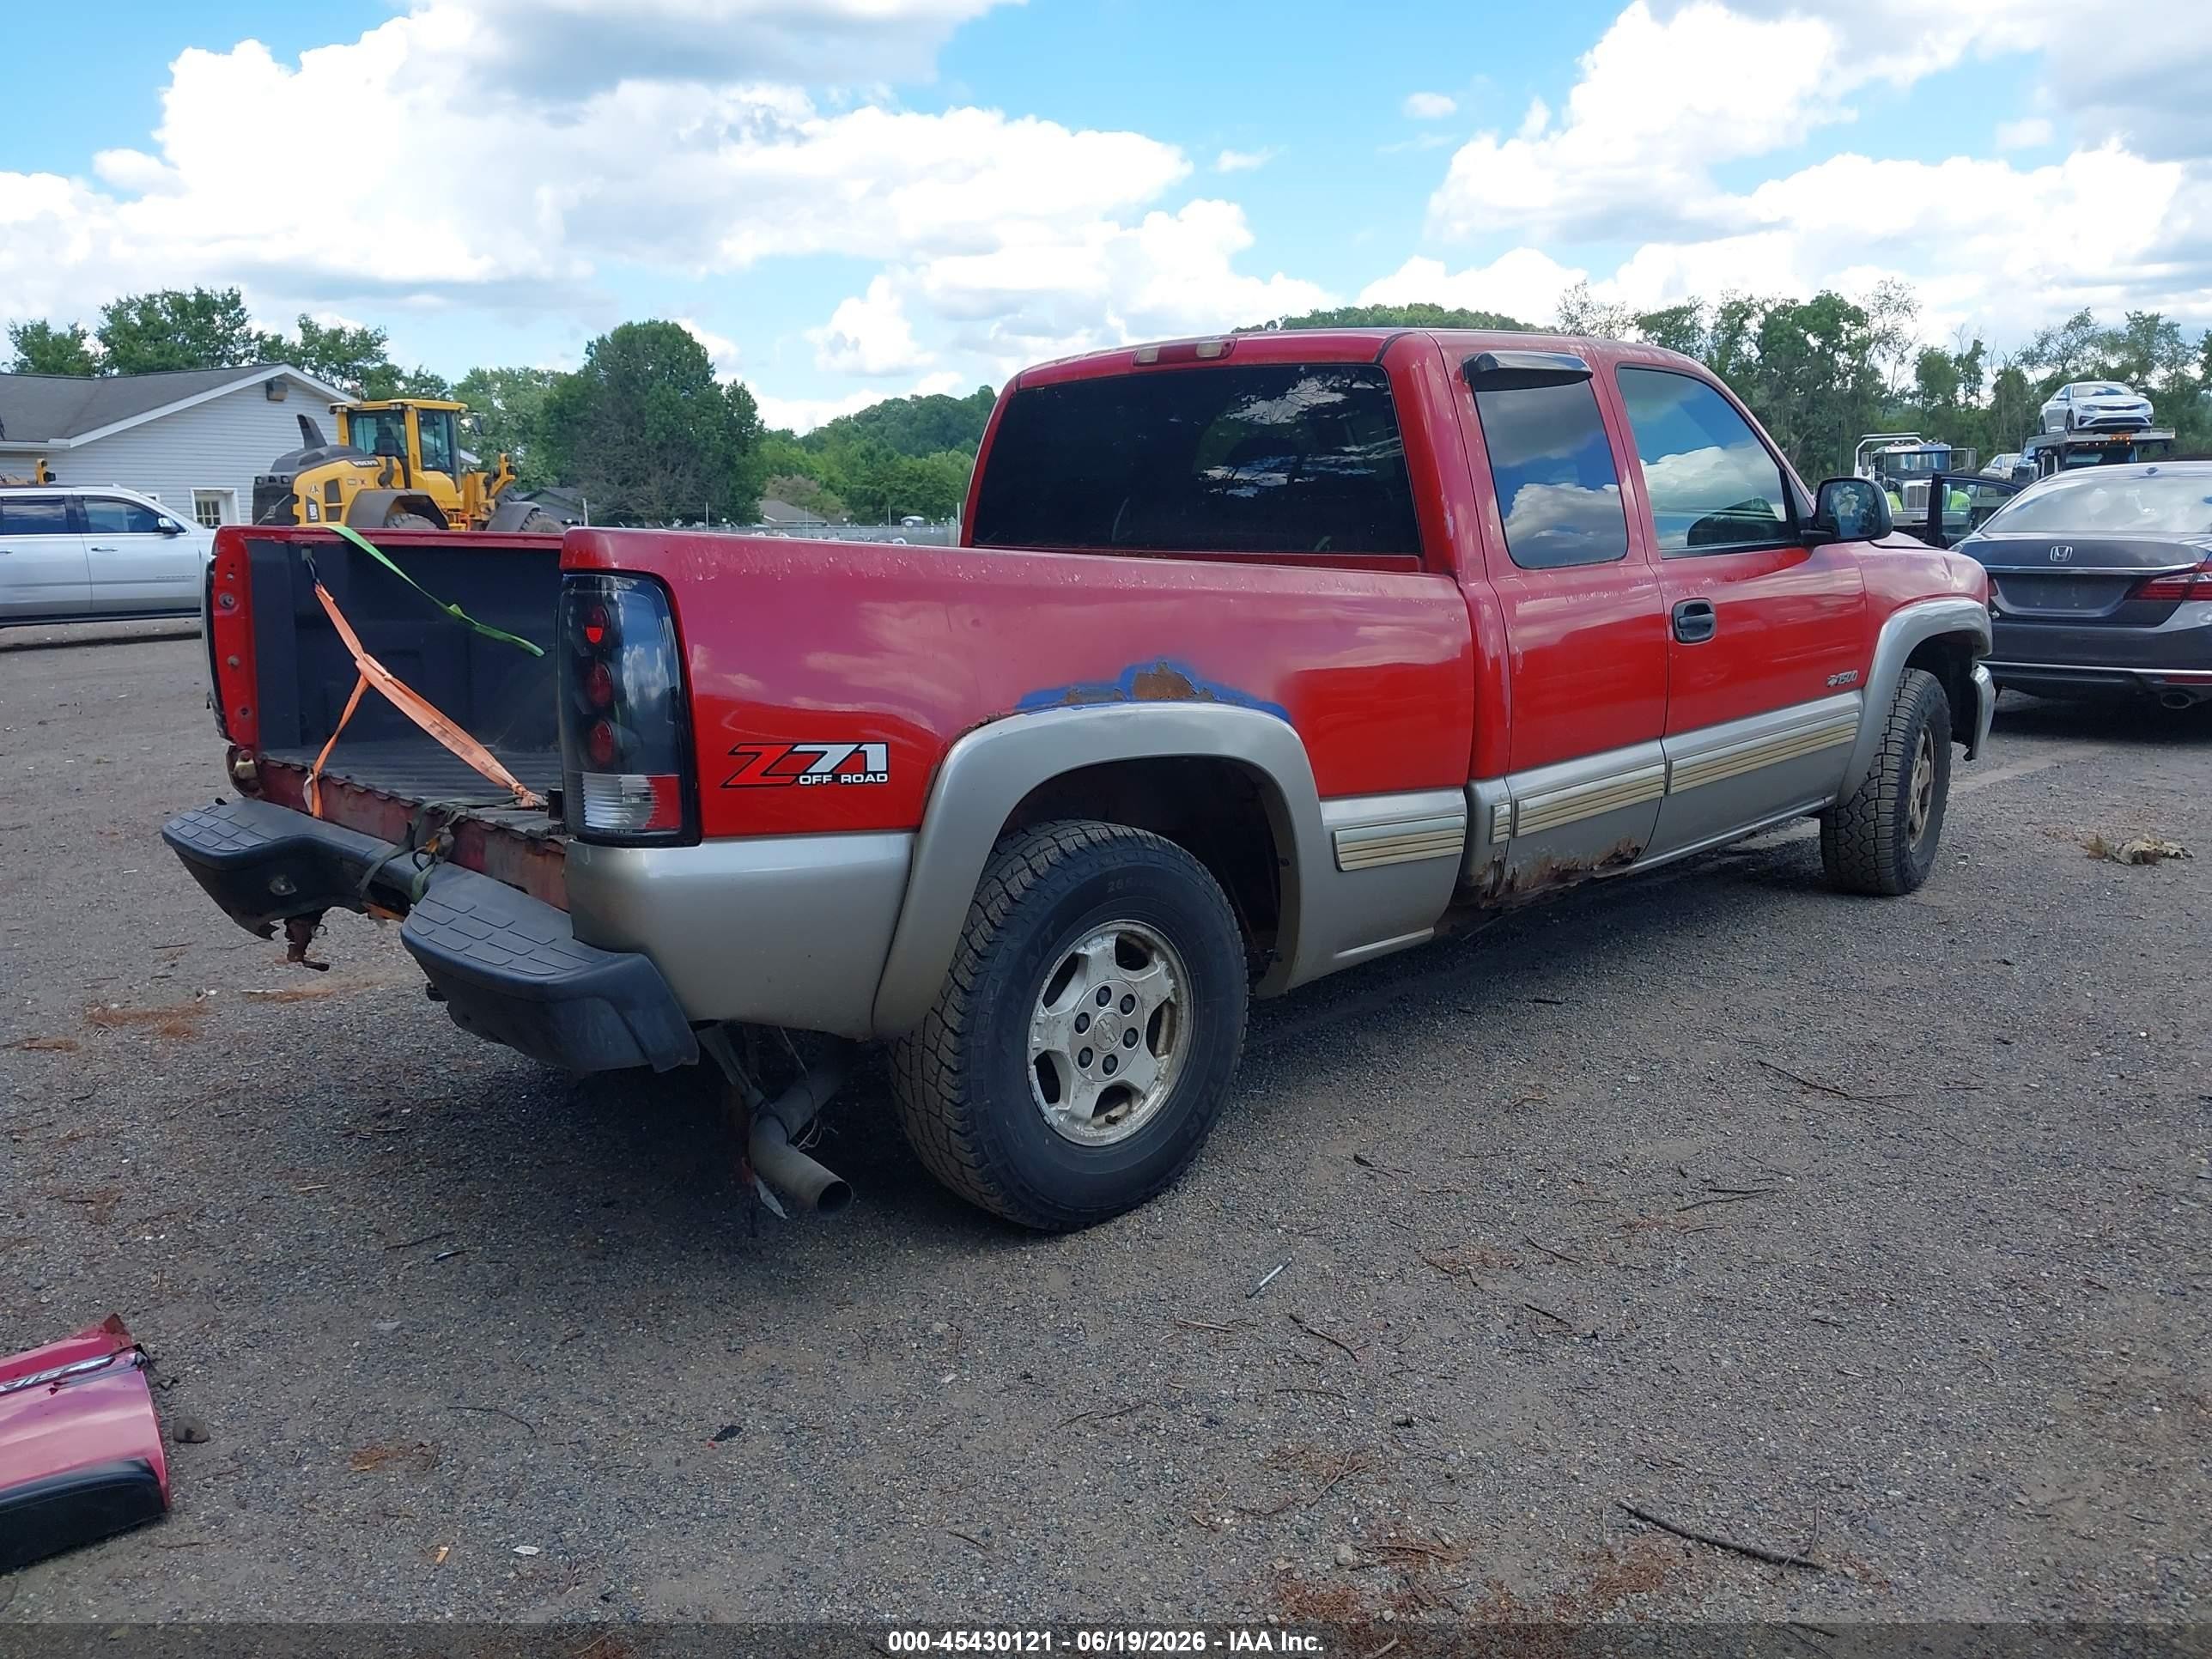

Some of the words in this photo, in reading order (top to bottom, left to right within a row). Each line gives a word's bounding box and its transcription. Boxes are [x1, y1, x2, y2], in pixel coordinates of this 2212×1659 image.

[720, 742, 889, 788] Z71
[799, 775, 833, 786] OFF
[840, 773, 889, 784] ROAD
